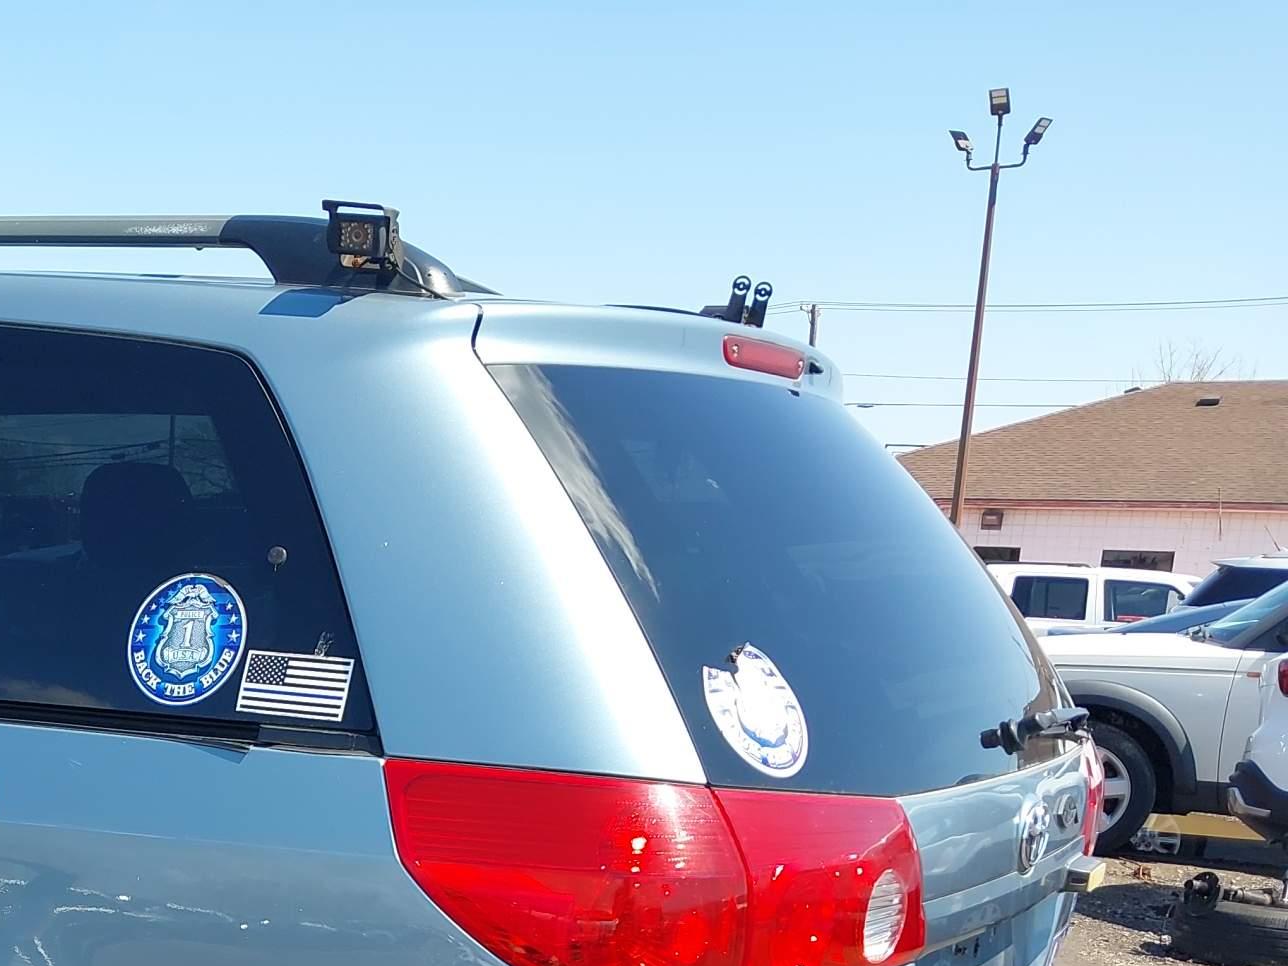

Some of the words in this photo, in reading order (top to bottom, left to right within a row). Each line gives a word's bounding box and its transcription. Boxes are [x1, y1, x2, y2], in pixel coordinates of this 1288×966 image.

[180, 620, 194, 648] 1
[134, 650, 161, 690] BACK
[164, 682, 195, 696] THE
[199, 648, 235, 688] BLUE
